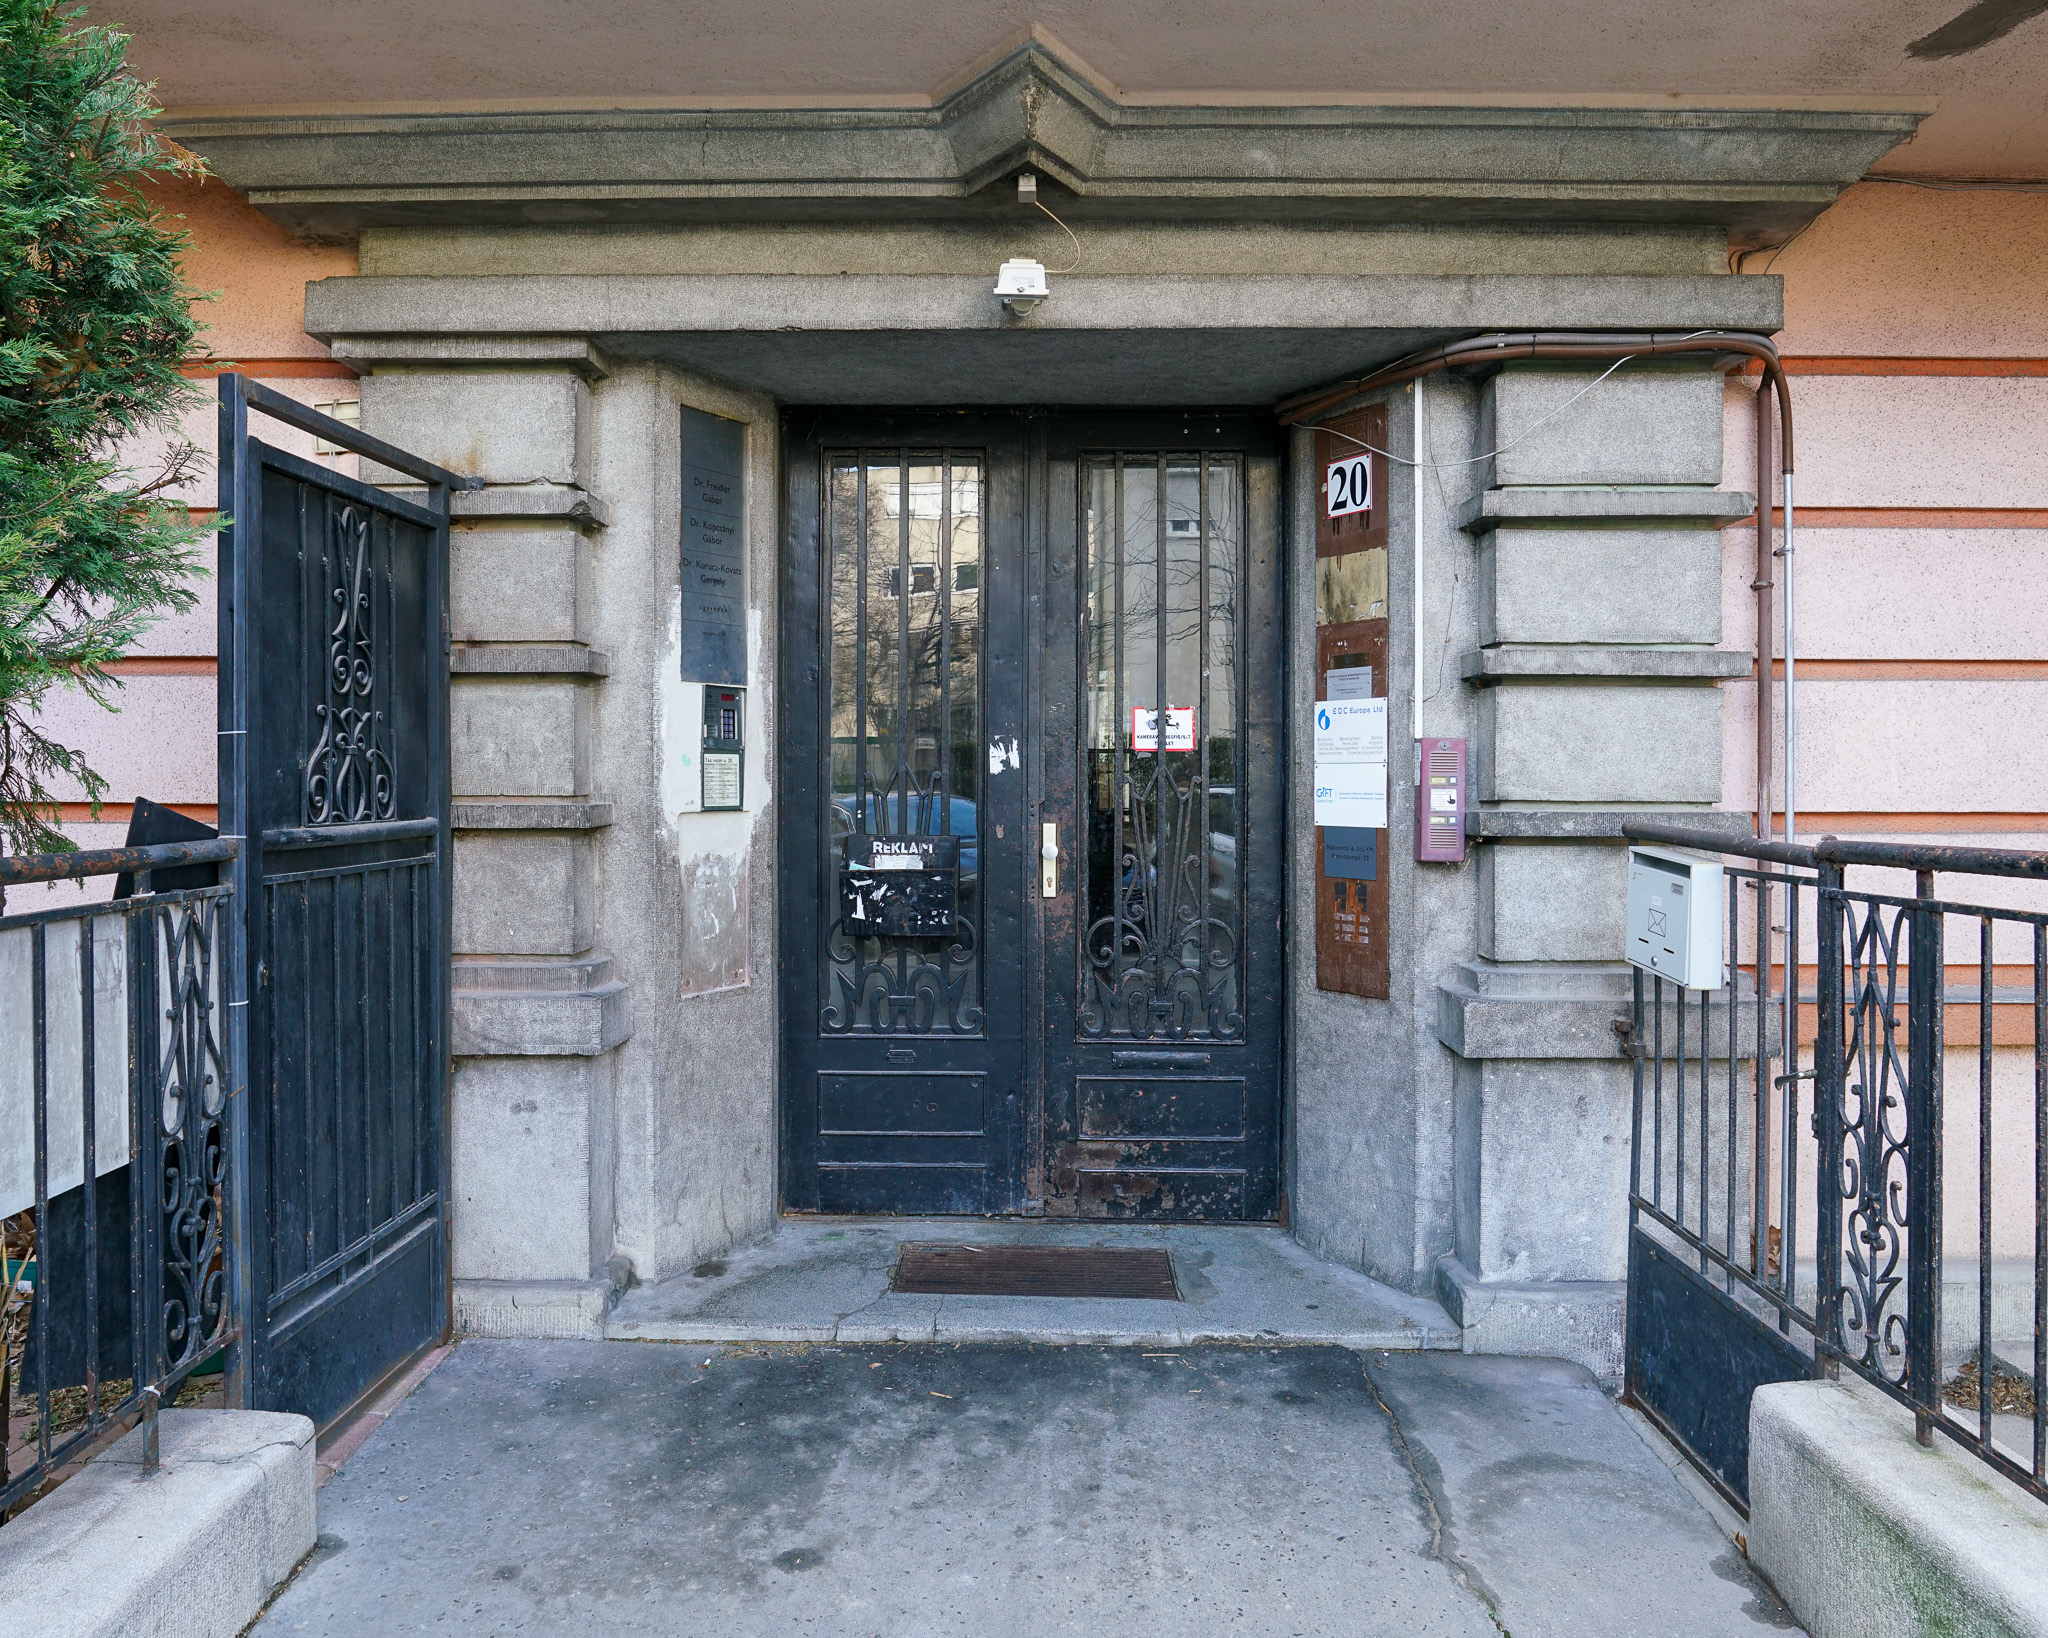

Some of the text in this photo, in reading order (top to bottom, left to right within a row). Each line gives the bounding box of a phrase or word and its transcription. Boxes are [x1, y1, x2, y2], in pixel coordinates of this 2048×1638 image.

[693, 477, 731, 493] Dr. Freidler
[1331, 462, 1368, 511] 20
[690, 517, 735, 536] Dr. Kopcsányi
[702, 534, 723, 545] Gábor
[682, 557, 694, 567] Dr.
[700, 574, 726, 588] Gergely
[1349, 707, 1371, 715] Europe
[1316, 787, 1333, 798] GIFT
[872, 841, 934, 854] REKLAM
